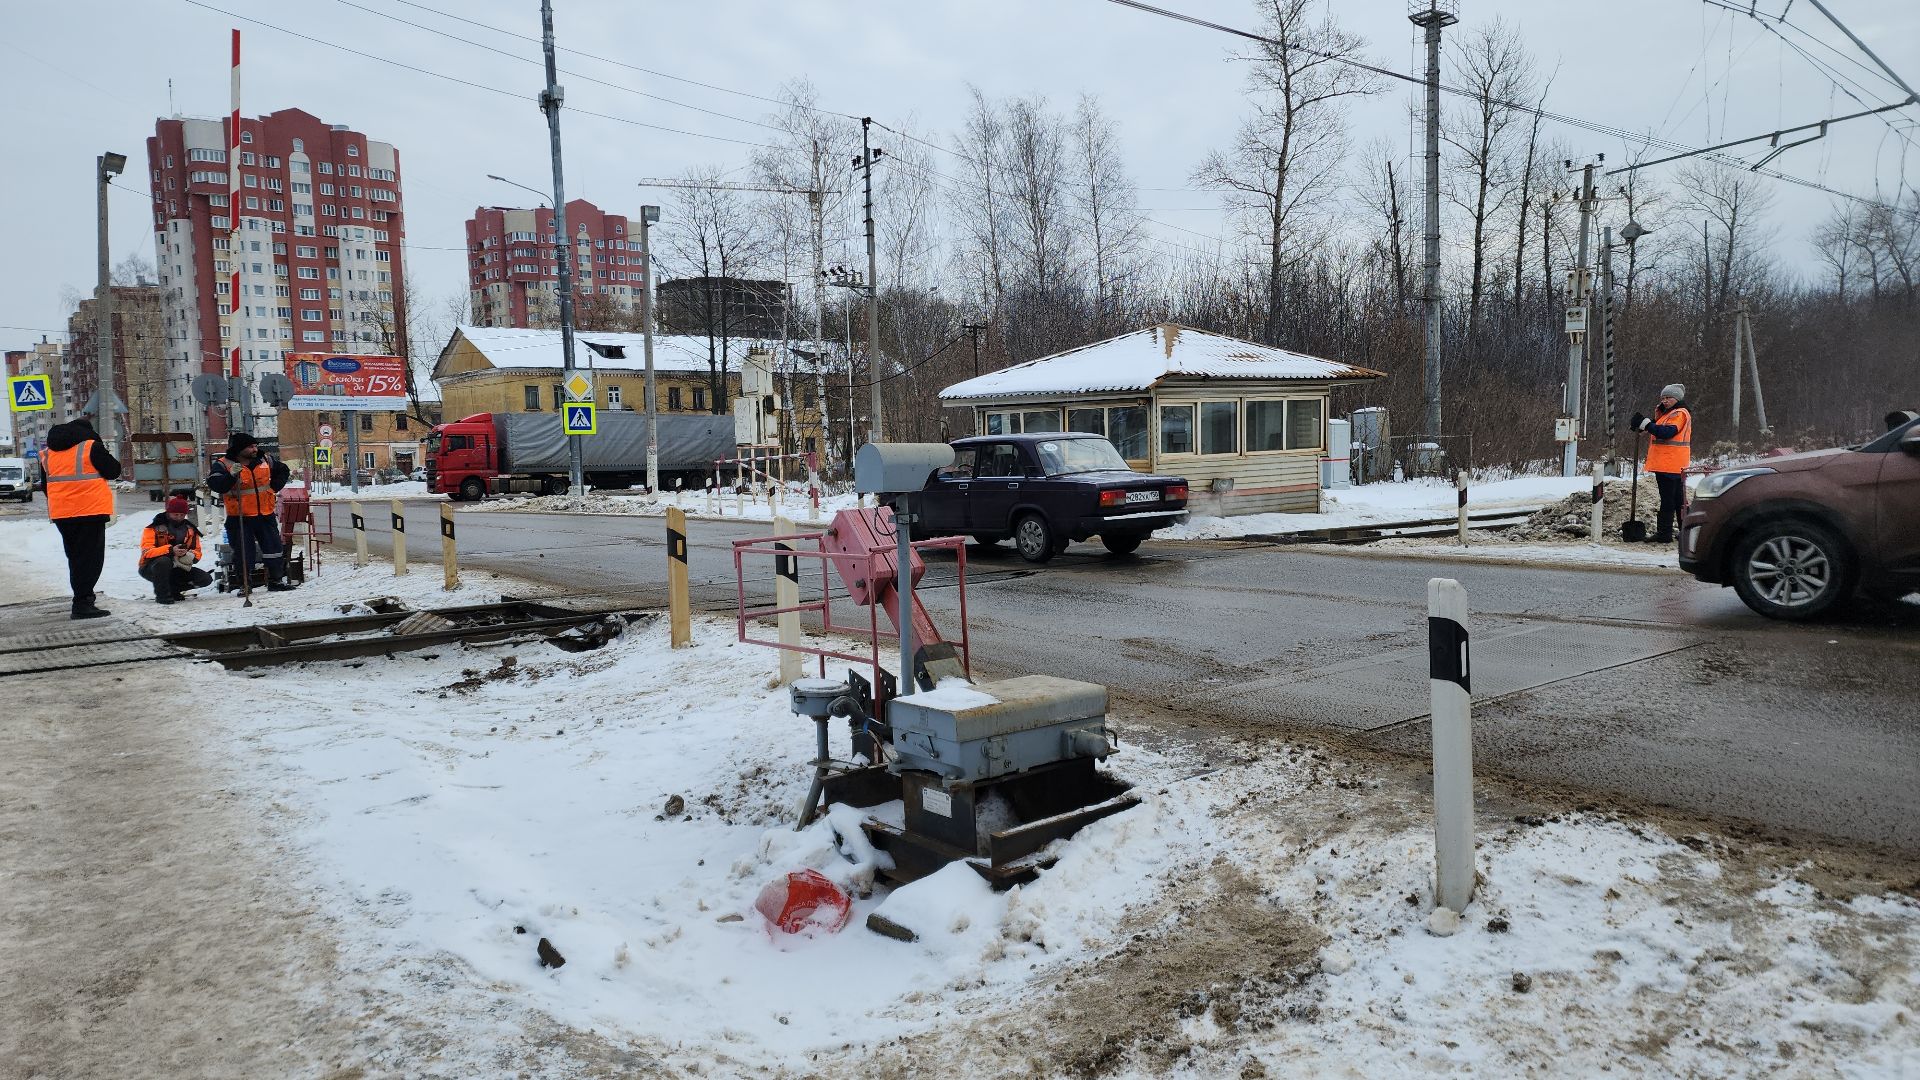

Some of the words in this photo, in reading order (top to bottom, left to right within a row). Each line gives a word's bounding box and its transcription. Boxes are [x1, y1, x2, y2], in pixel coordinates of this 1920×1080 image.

[328, 375, 364, 384] Скидки
[353, 383, 365, 391] до
[367, 375, 402, 393] 15%
